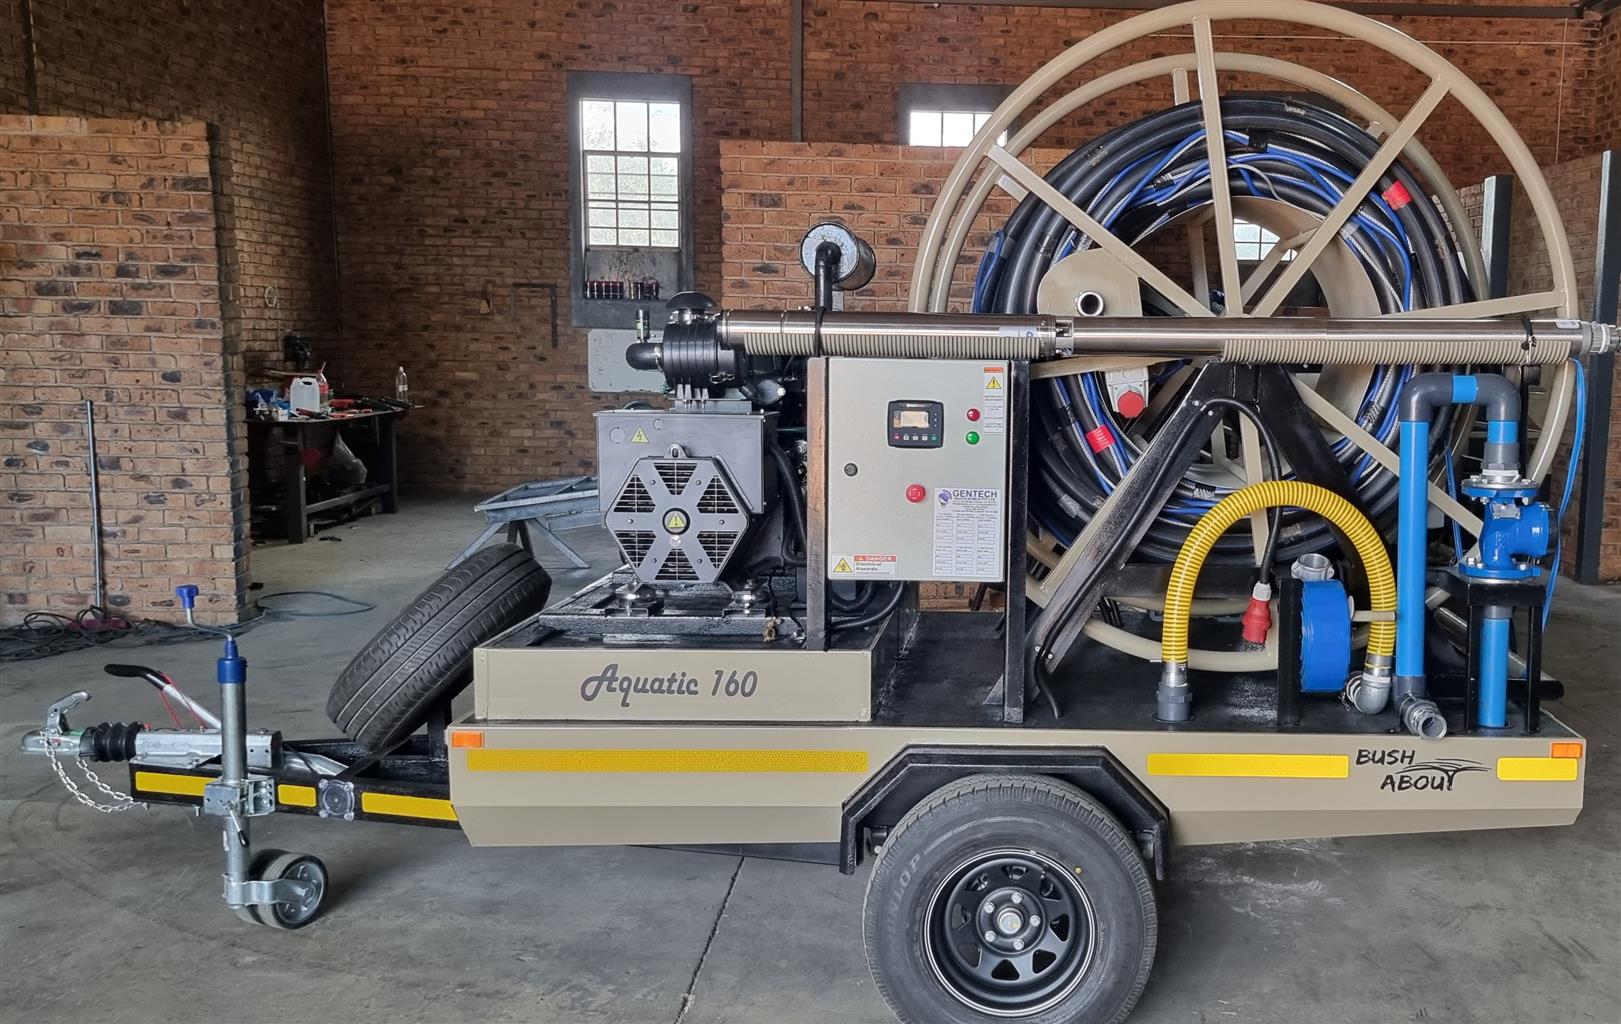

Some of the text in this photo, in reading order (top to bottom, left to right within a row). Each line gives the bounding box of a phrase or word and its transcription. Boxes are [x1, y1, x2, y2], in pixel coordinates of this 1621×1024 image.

[952, 489, 998, 498] GENTECH
[580, 663, 758, 708] Aquatic 160
[1355, 749, 1416, 766] BUSH
[1380, 769, 1454, 792] ABOUT
[886, 853, 921, 948] UNLOP
